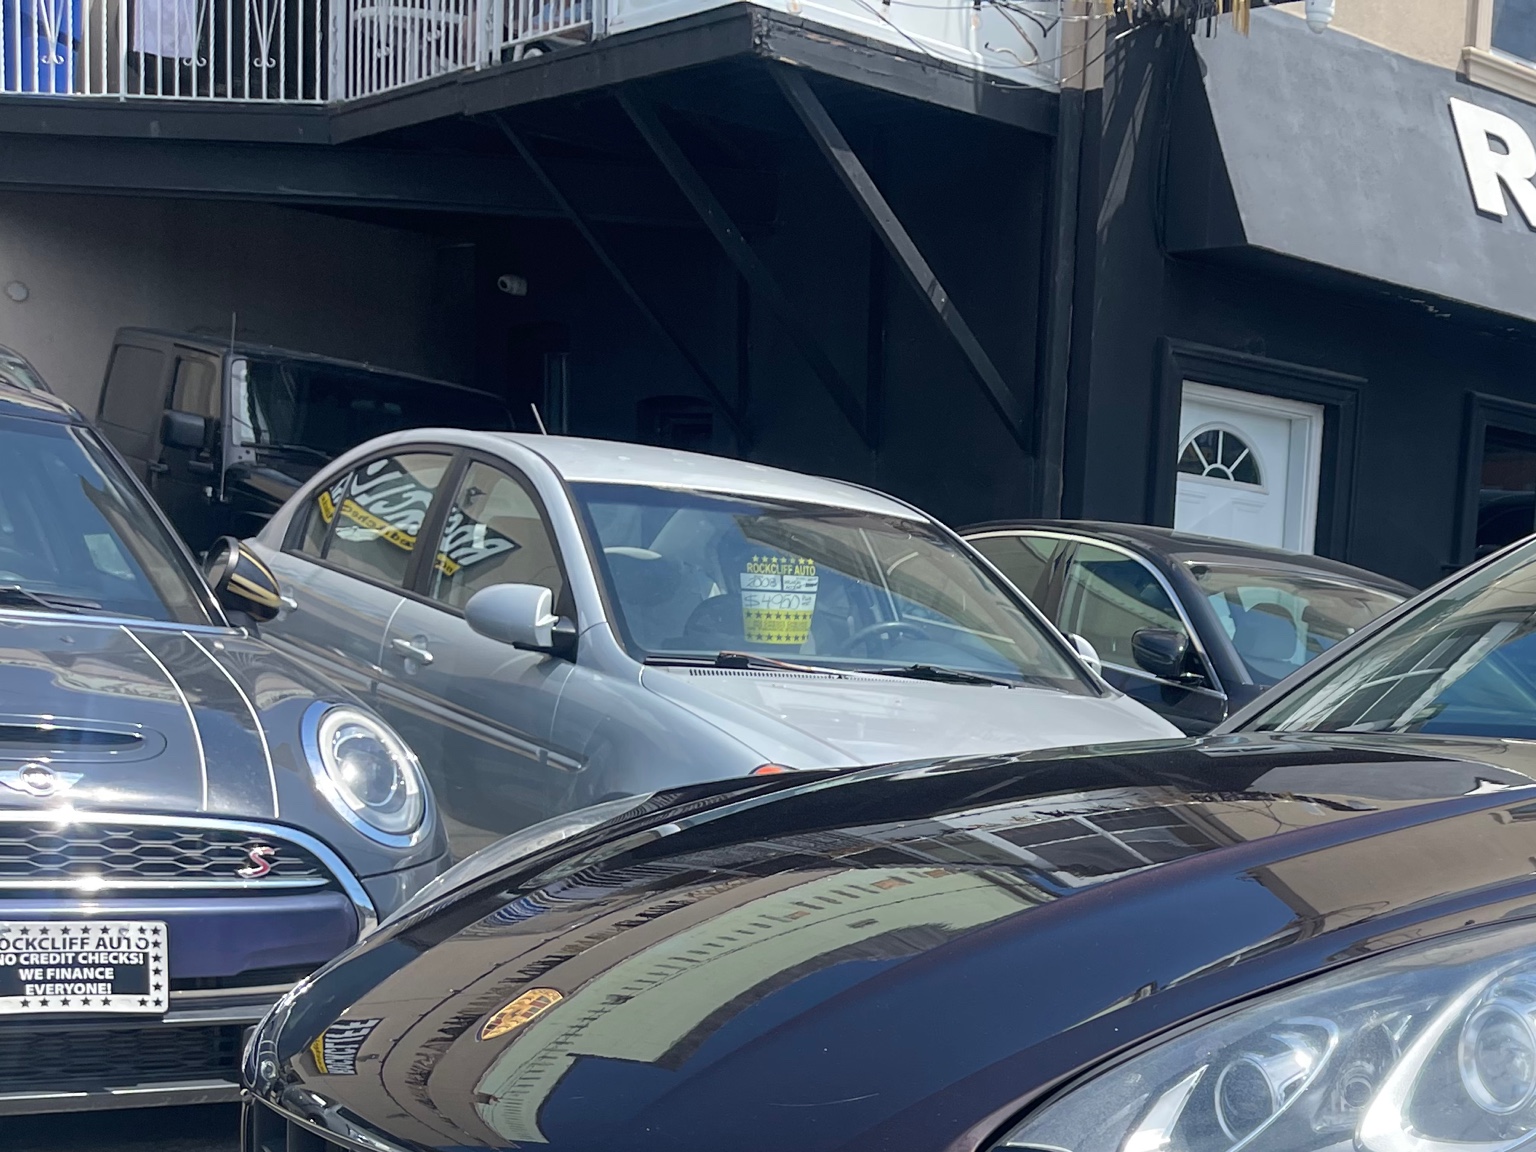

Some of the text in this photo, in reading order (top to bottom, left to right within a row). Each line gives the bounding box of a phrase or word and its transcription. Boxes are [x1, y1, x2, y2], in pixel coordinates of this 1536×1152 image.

[746, 562, 816, 576] ROCKCLIFF AUTO
[237, 846, 275, 879] S
[0, 937, 150, 950] OCKCLIFF AUTO
[20, 952, 75, 965] CREDIT
[78, 952, 144, 965] CHECKS!
[19, 967, 114, 980] WE FINANCE
[25, 983, 113, 996] EVERYONE!
